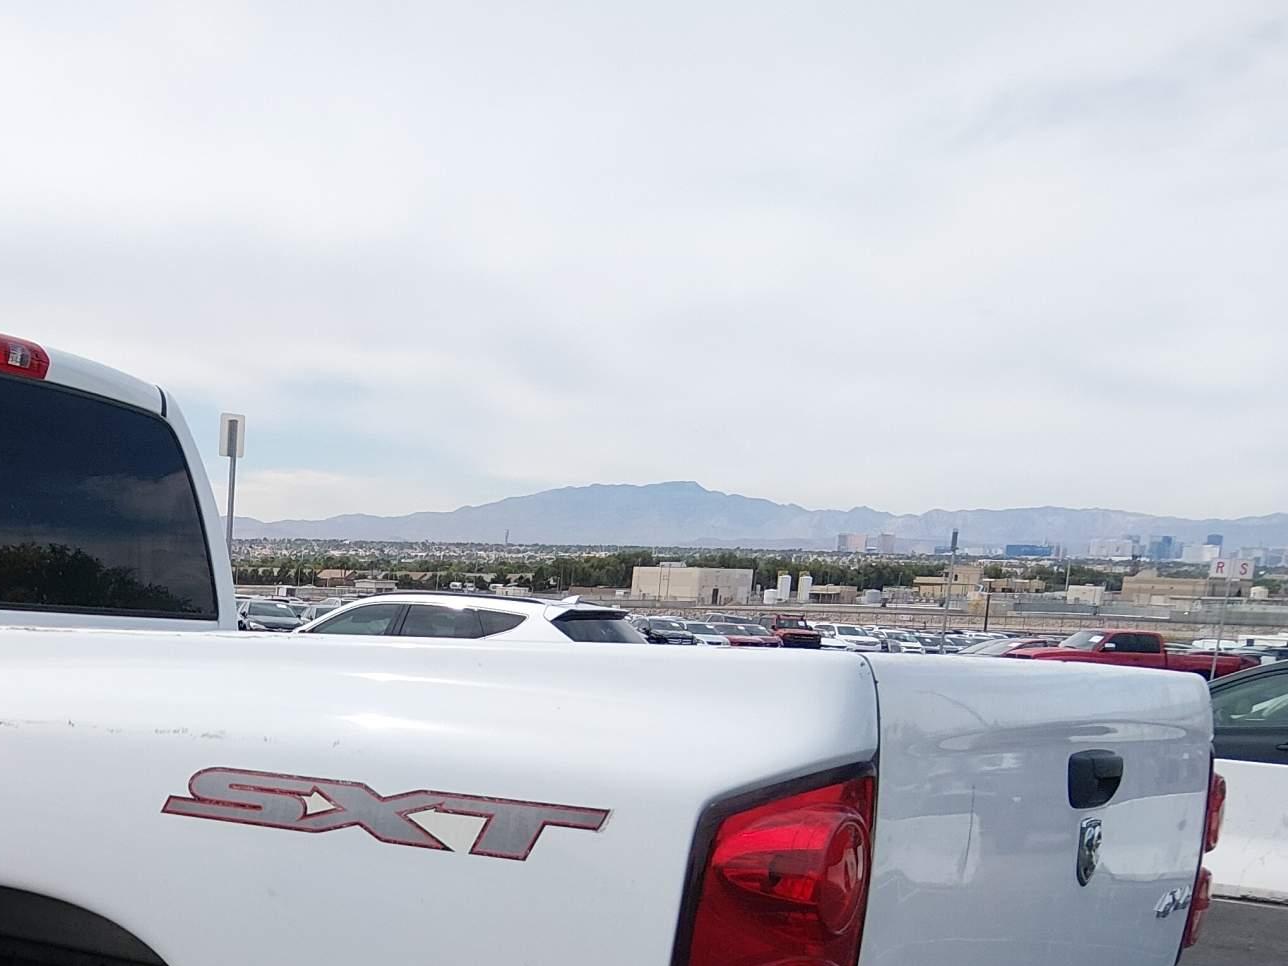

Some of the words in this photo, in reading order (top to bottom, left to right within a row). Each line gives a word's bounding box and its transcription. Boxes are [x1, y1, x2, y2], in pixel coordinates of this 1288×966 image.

[1215, 561, 1225, 574] R
[1239, 562, 1249, 575] S
[160, 766, 612, 861] SXT
